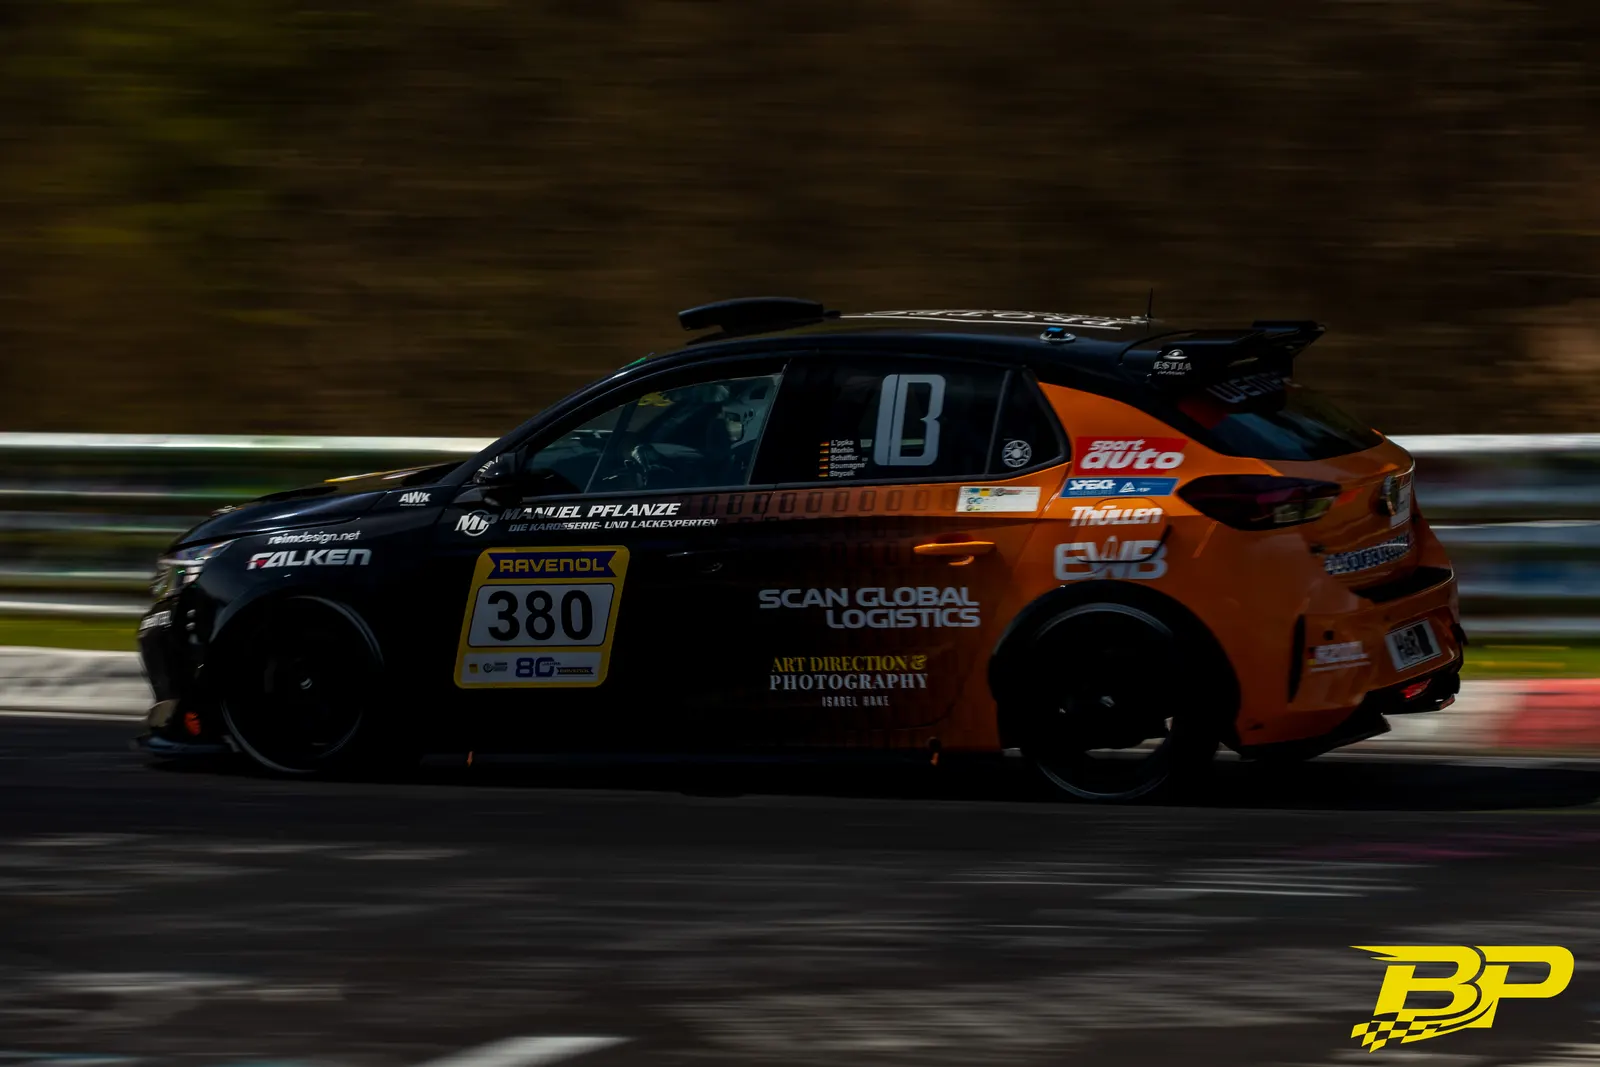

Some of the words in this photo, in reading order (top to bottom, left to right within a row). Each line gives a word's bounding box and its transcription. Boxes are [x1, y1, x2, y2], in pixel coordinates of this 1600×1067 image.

[1152, 360, 1193, 371] ESTIA
[1088, 439, 1145, 453] sport
[1080, 448, 1185, 470] auto
[398, 491, 431, 503] AWK
[501, 504, 582, 521] MANUEL
[587, 502, 682, 519] PFLANZE
[508, 523, 527, 533] DIE
[604, 520, 630, 530] UND
[632, 518, 719, 529] LACKEXPERTEN
[266, 530, 362, 546] reimdesign.net
[246, 549, 372, 571] FALKEN
[499, 557, 605, 573] RAVENOL
[1053, 535, 1169, 581] EWB
[758, 587, 849, 609] SCAN
[855, 586, 981, 607] GLOBAL
[487, 590, 593, 641] 380
[825, 607, 981, 629] LOGISTICS
[771, 656, 807, 673] ART
[809, 654, 907, 672] DIRECTION
[910, 654, 928, 670] &
[768, 673, 928, 691] PHOTOGRAPHY
[821, 695, 858, 708] ISABEL
